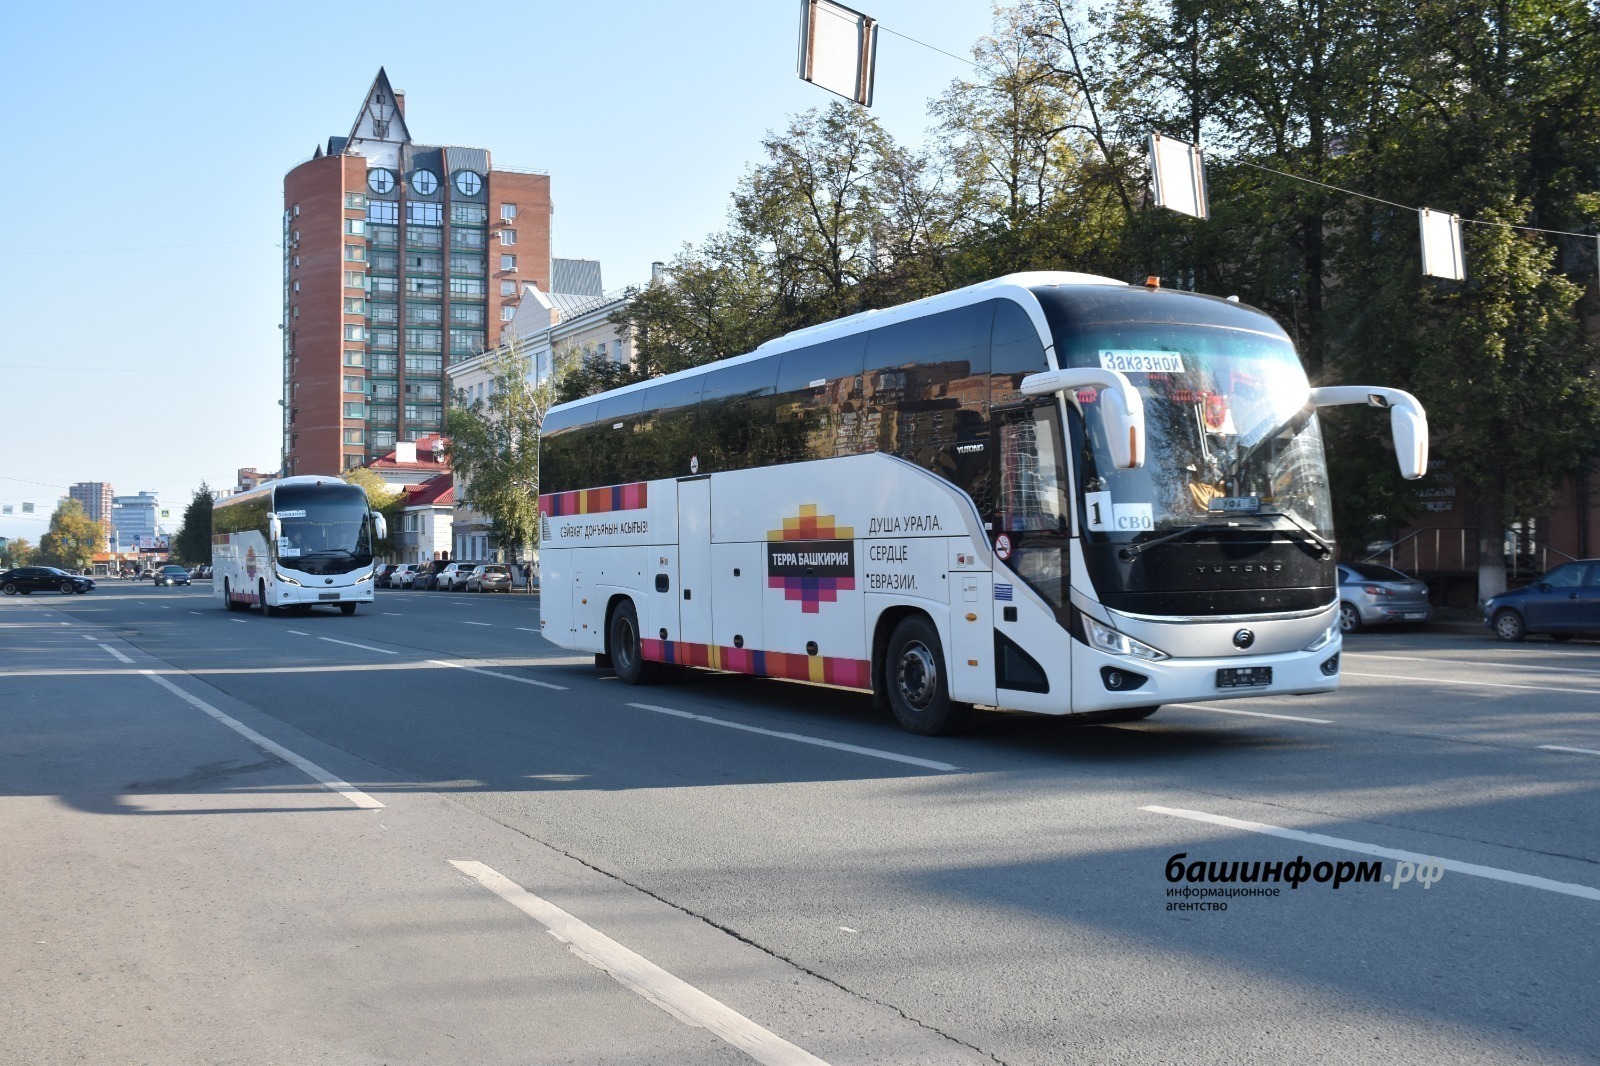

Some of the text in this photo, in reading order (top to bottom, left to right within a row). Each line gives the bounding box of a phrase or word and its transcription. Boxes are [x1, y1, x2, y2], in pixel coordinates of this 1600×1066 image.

[1104, 351, 1180, 371] Заказной
[956, 443, 985, 455] YUTONG
[1090, 501, 1102, 525] 1
[1222, 499, 1242, 509] УФА
[869, 514, 943, 536] ДУША УРАЛА.
[772, 552, 849, 566] ТЕРРА БАШКИРИЯ
[869, 545, 908, 564] СЕРДЦЕ
[870, 573, 918, 590] ЕВРАЗИИ.
